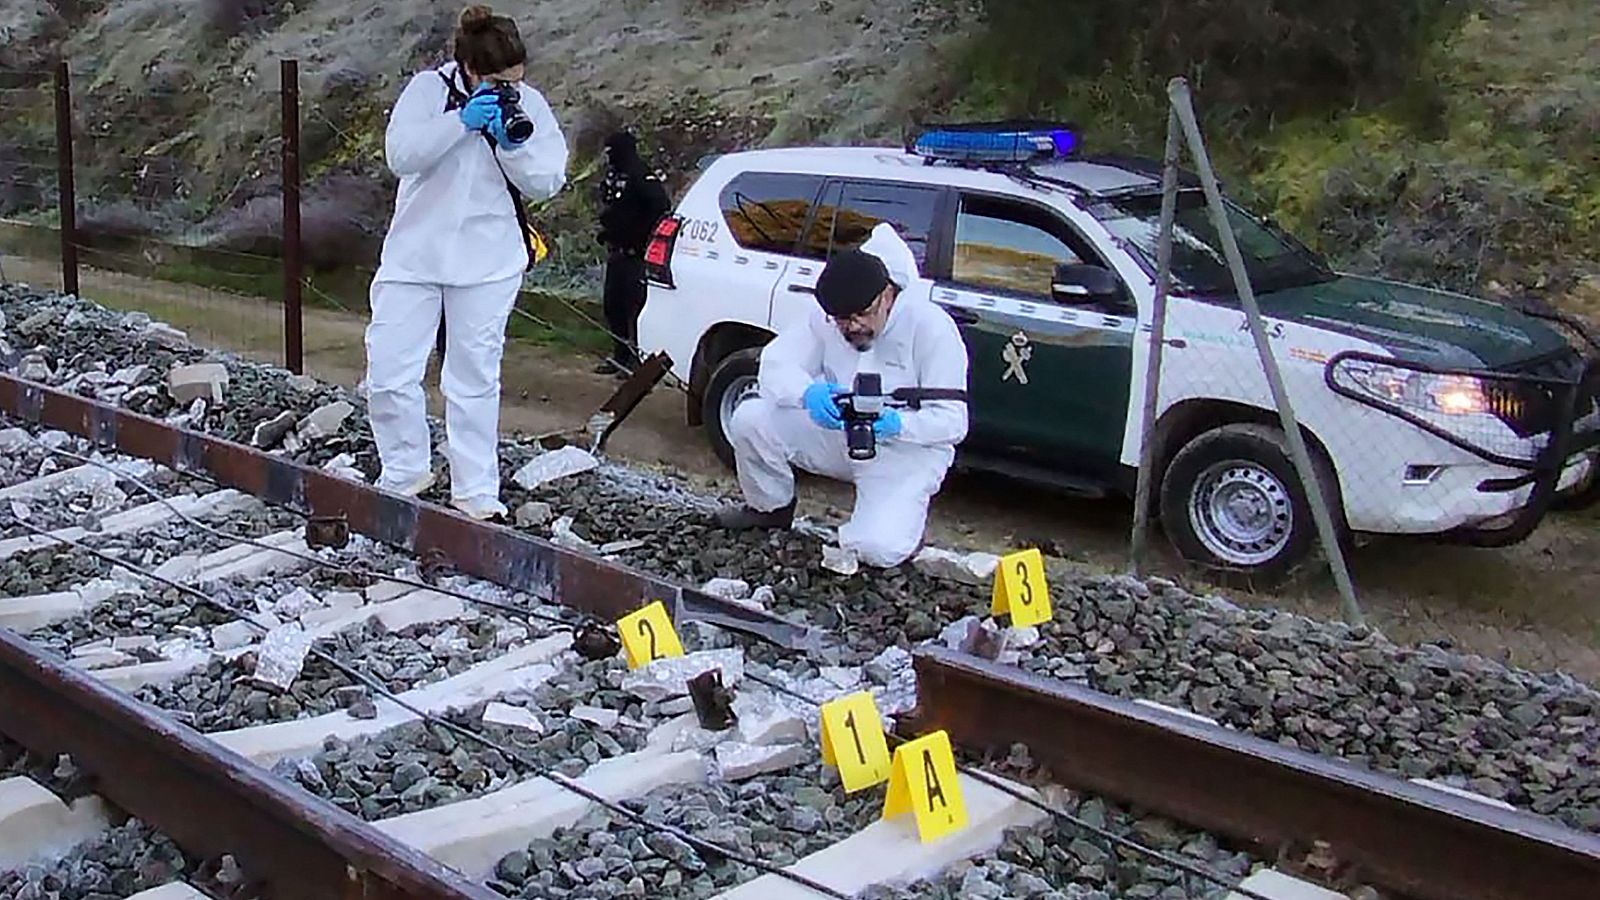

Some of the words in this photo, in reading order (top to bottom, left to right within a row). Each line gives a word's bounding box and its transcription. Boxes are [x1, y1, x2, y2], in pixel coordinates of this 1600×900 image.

[690, 219, 719, 243] 062
[1016, 561, 1032, 606] 3
[638, 619, 665, 660] 2
[845, 709, 866, 765] 1
[923, 749, 947, 812] A
